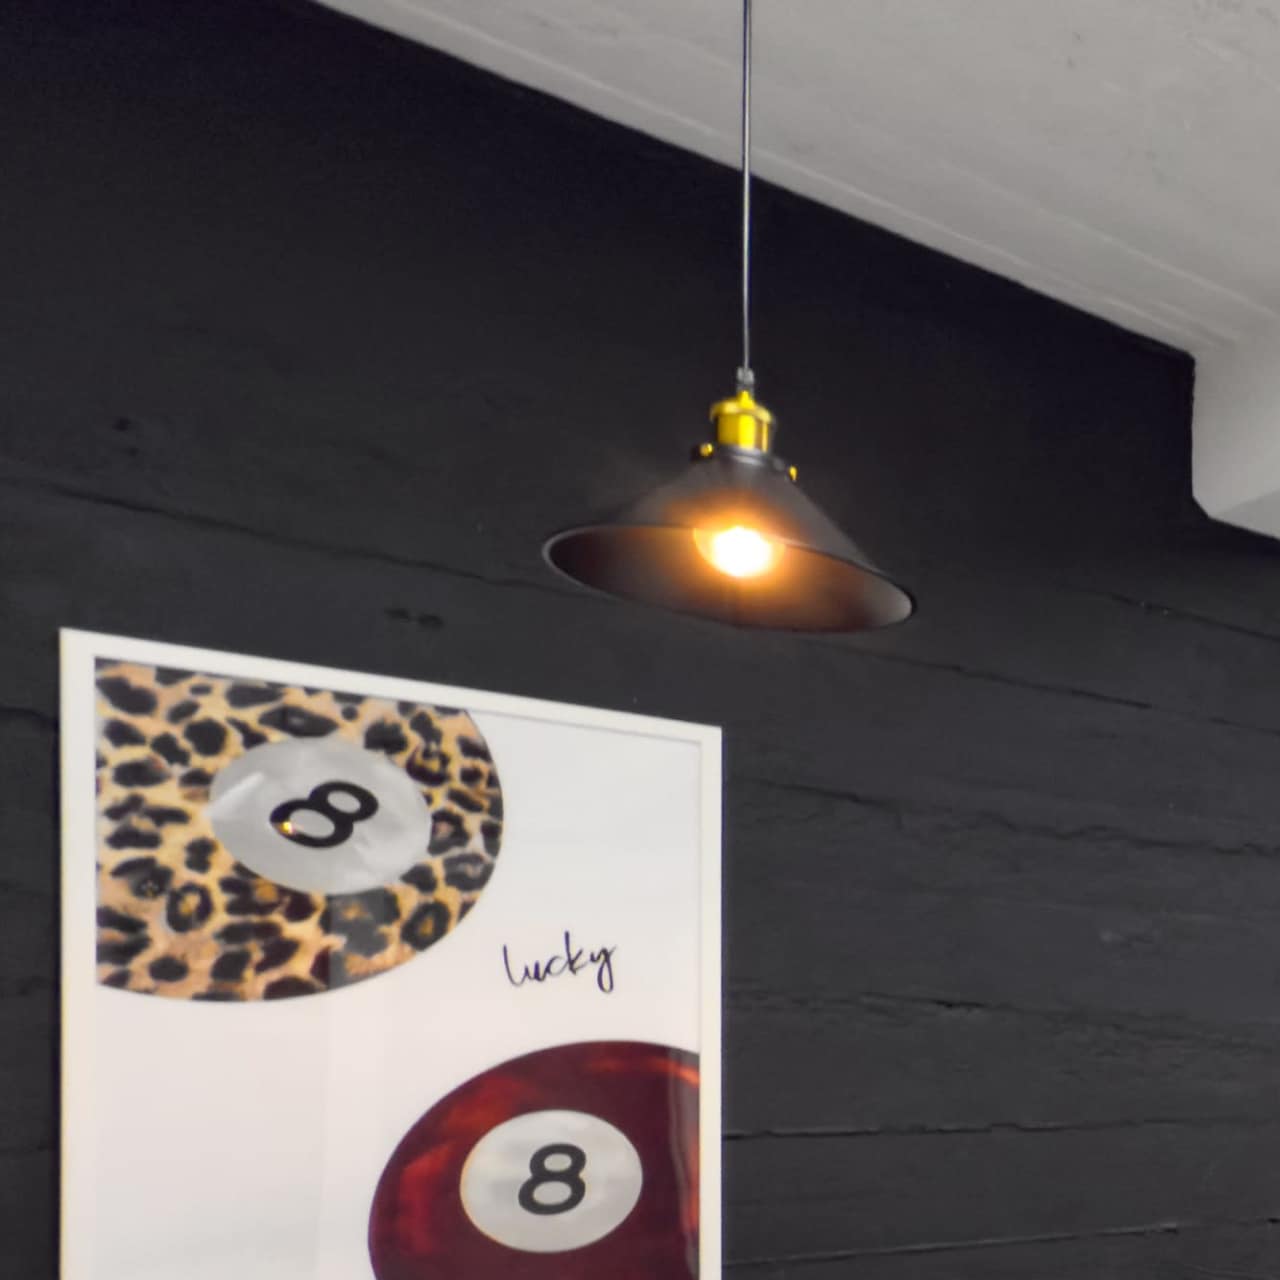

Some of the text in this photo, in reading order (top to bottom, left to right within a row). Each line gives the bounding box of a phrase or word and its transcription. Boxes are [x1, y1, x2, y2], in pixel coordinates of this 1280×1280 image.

[270, 780, 379, 848] 8
[503, 930, 617, 994] lucky
[518, 1143, 587, 1215] 8
